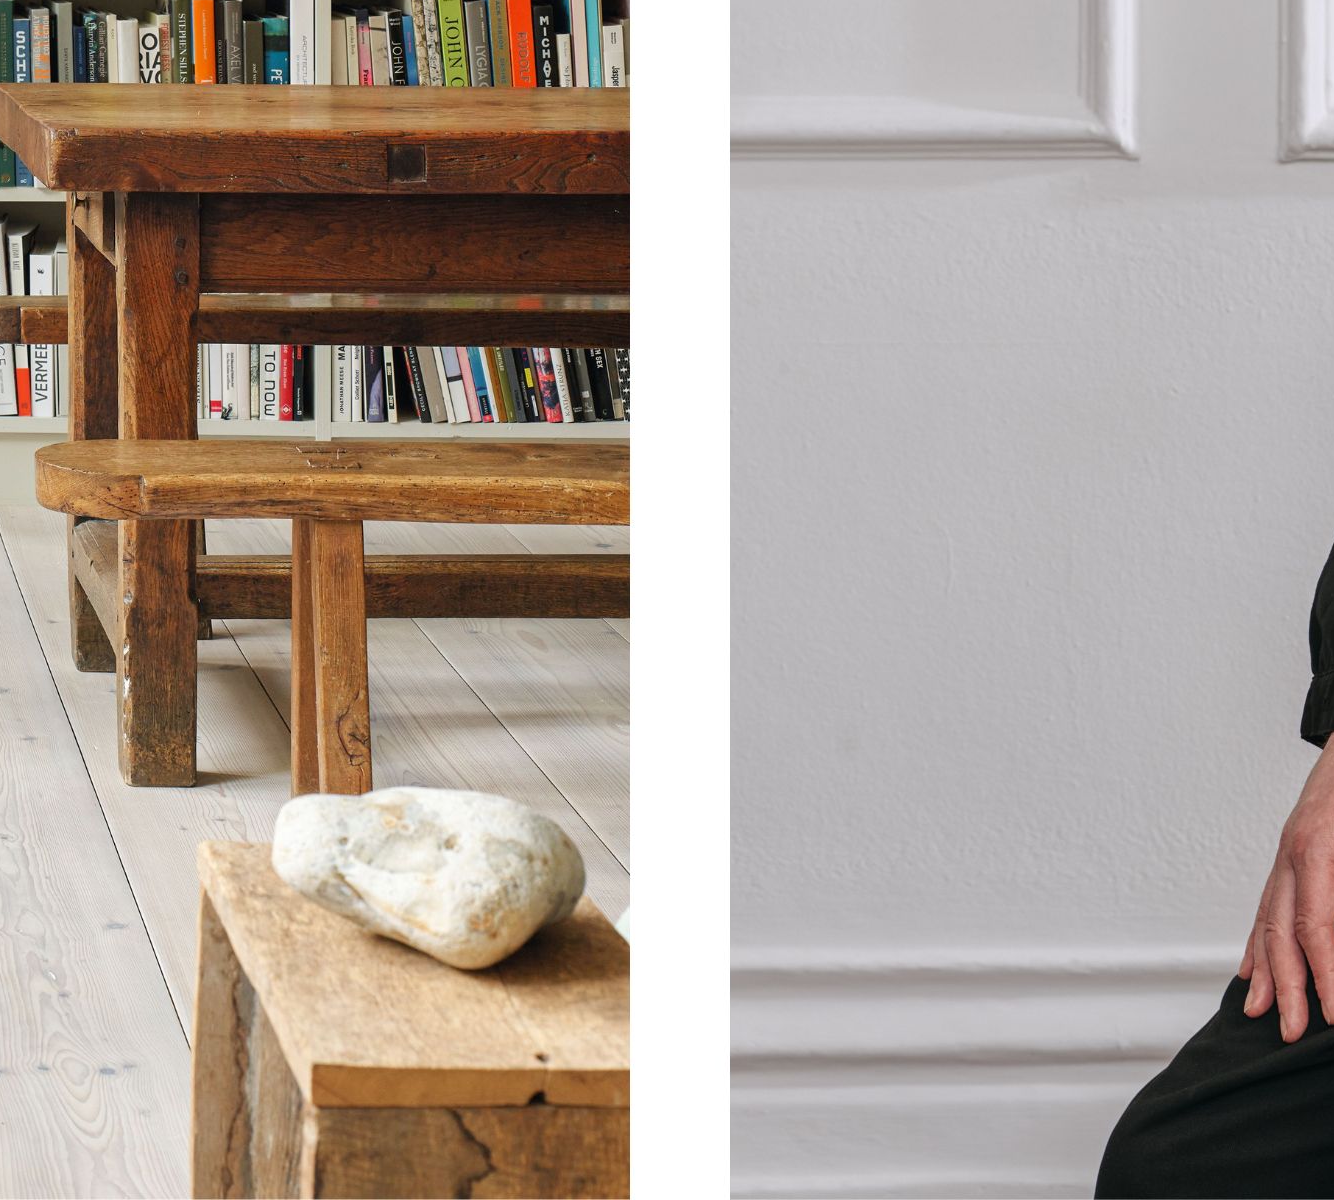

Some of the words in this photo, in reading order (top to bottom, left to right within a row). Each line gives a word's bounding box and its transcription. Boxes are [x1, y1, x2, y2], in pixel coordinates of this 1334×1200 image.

[444, 17, 463, 68] JOHN
[518, 32, 531, 83] RUDOLF
[556, 364, 565, 392] STRUNZ
[562, 394, 571, 417] KATJA
